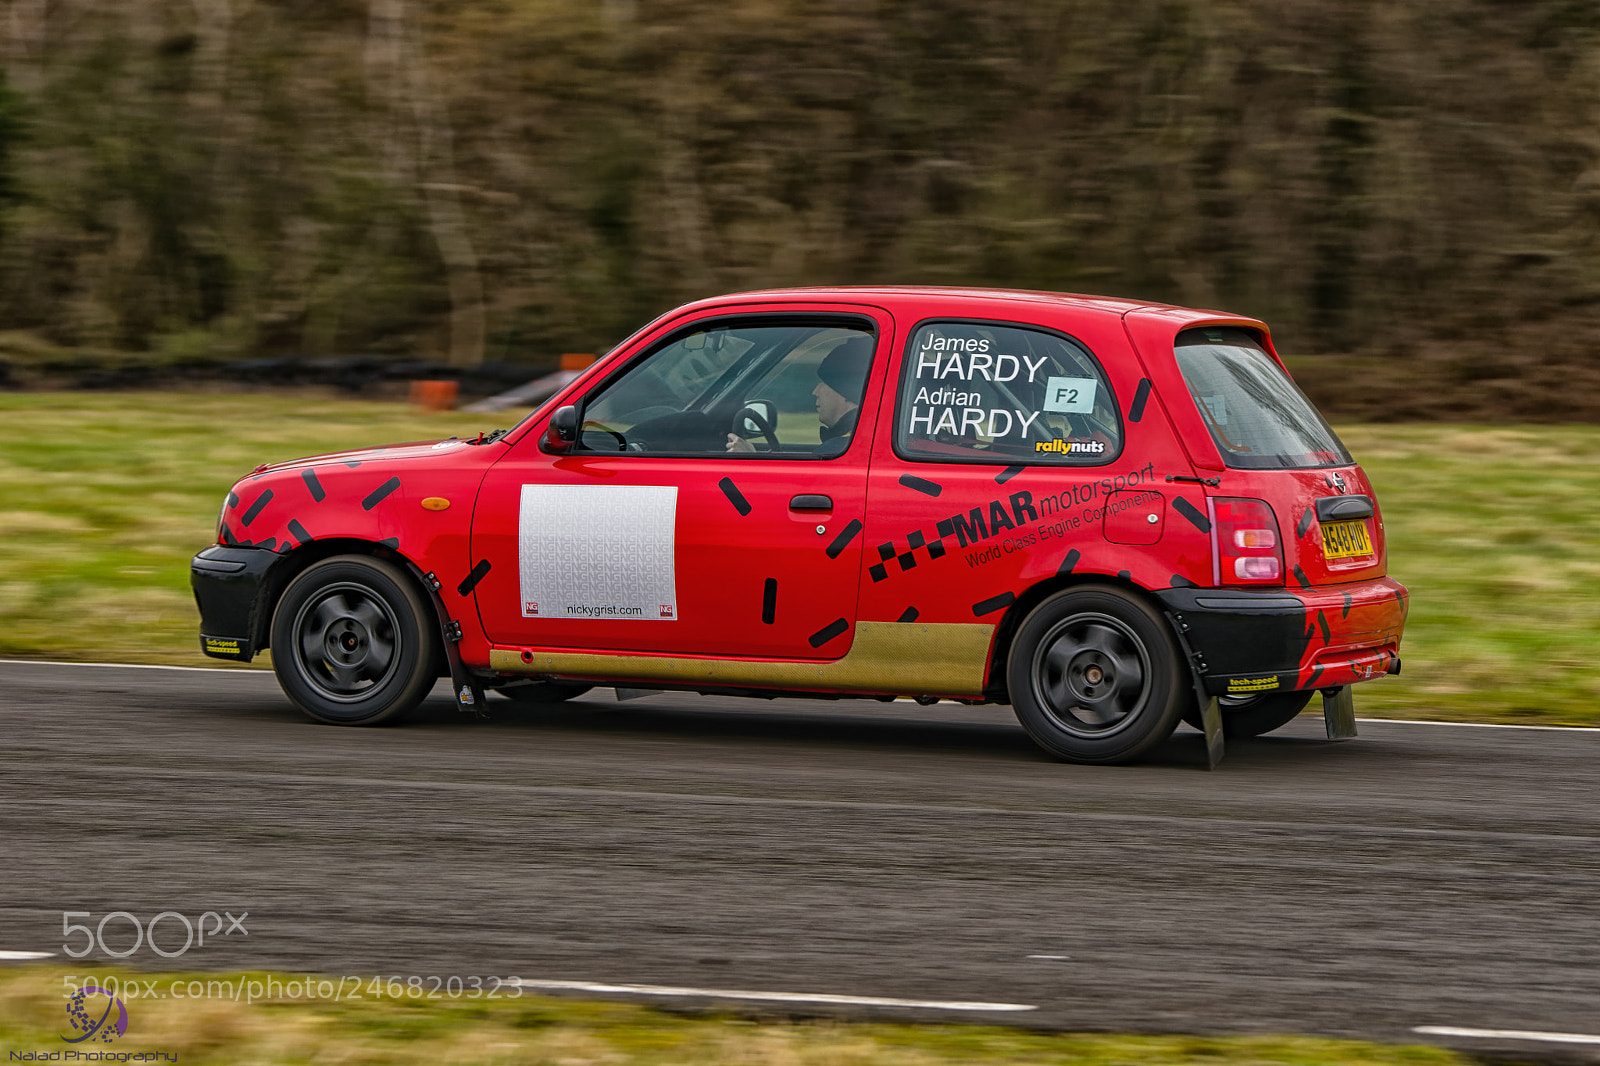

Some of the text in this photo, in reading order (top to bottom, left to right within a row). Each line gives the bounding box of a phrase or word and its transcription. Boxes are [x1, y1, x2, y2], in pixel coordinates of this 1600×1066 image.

[922, 333, 990, 352] James
[916, 352, 1048, 383] HARDY
[914, 386, 981, 407] Adrian
[1055, 388, 1079, 404] F2
[909, 407, 1040, 439] HARDY
[1035, 438, 1105, 455] rallynuts
[953, 462, 1156, 548] MAR motorsport
[965, 488, 1161, 569] World Class Engine Components
[567, 604, 642, 617] nickygrist.com
